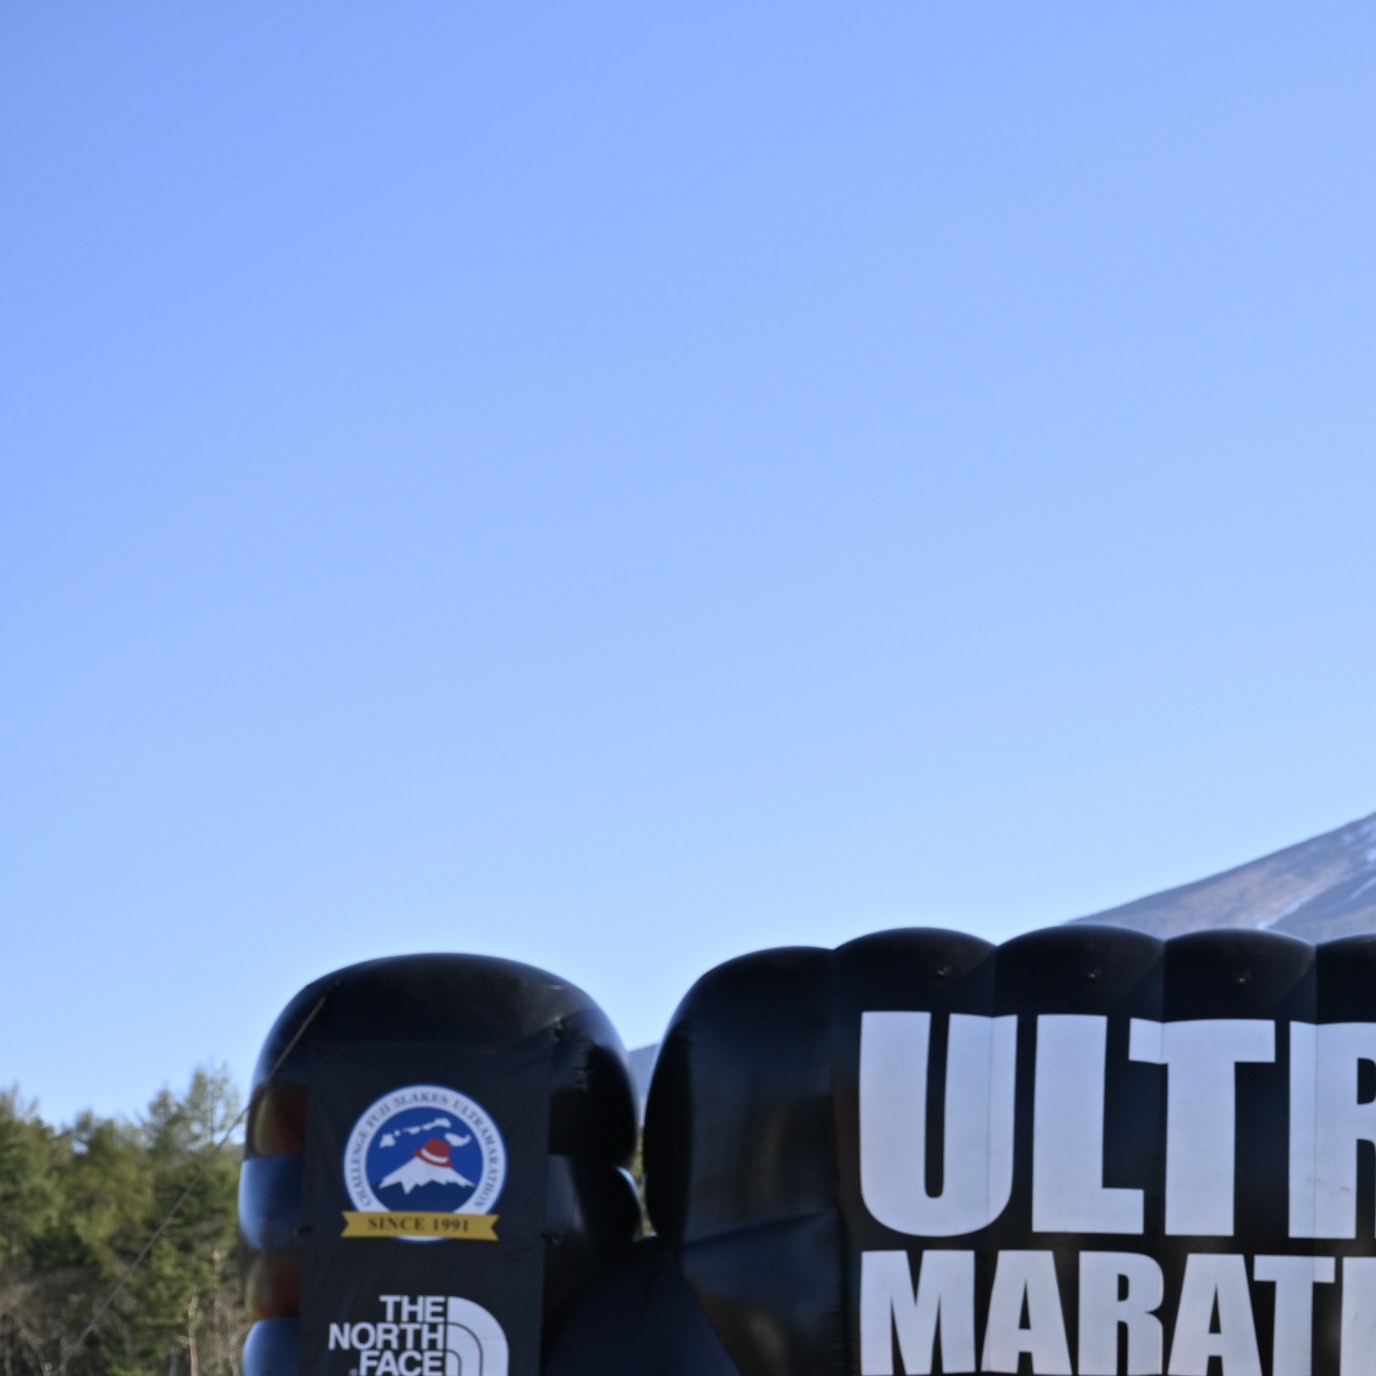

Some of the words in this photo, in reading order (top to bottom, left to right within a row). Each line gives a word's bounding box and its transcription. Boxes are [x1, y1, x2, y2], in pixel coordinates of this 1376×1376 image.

[368, 1216, 424, 1231] SINCE
[433, 1217, 469, 1232] 1991
[379, 1295, 446, 1322] THE
[328, 1321, 445, 1351] NORTH
